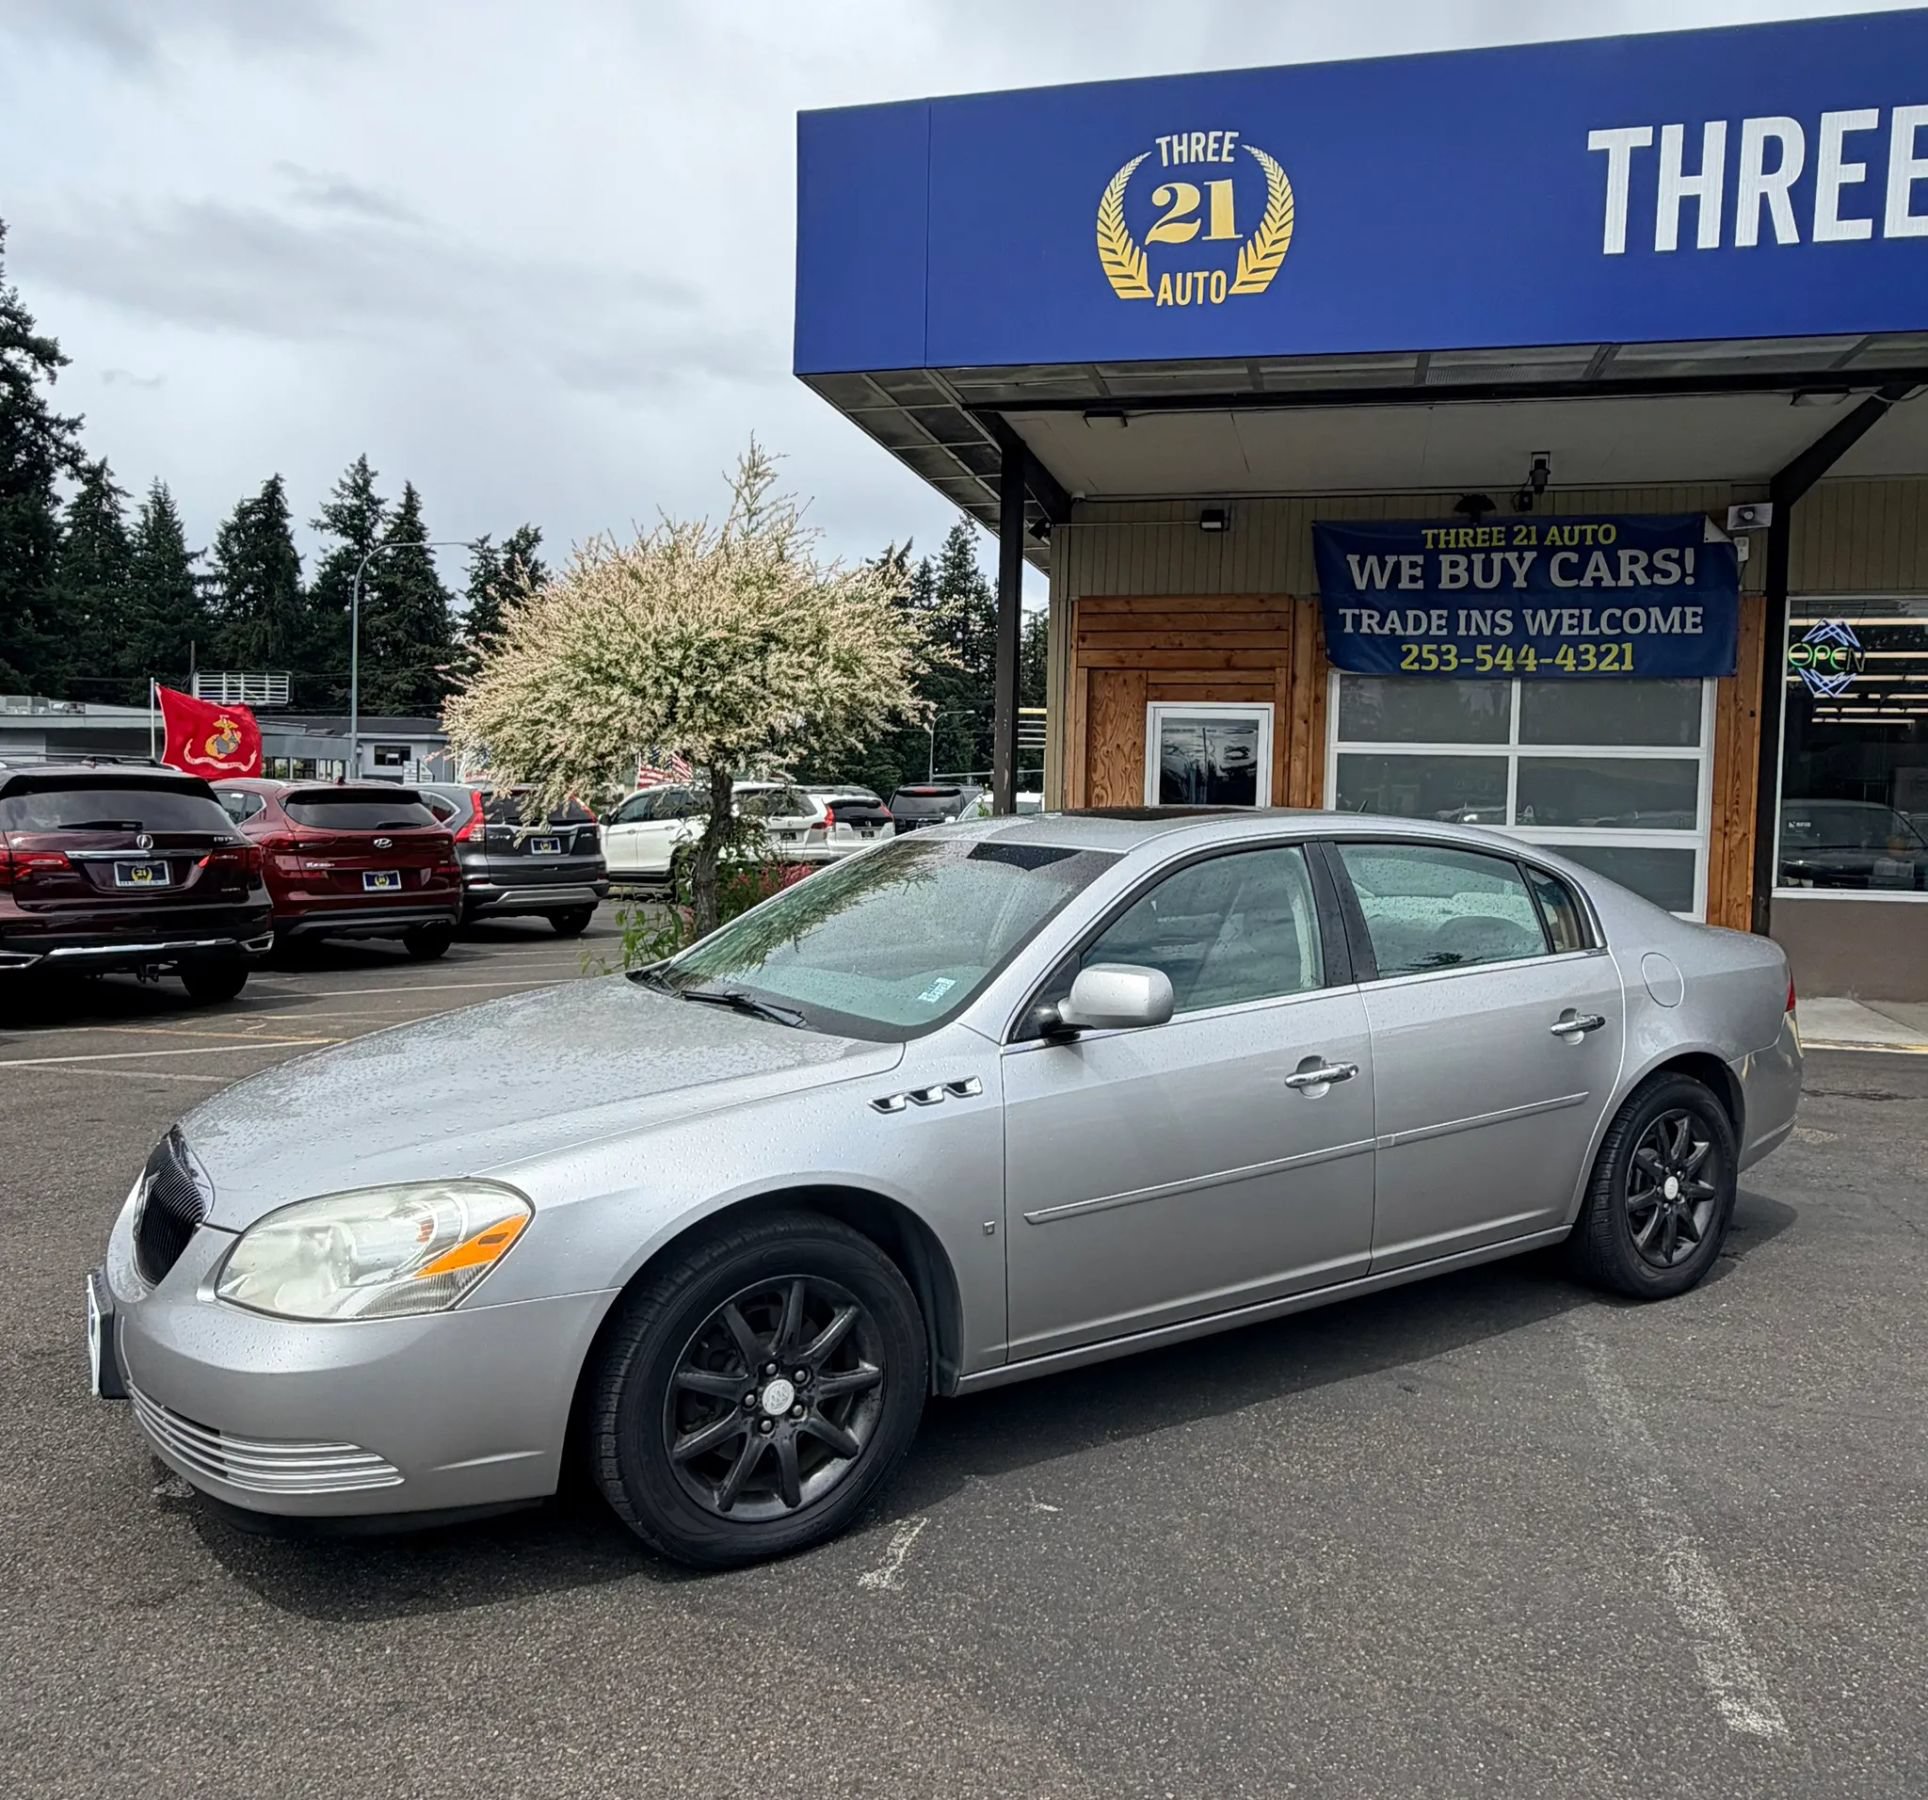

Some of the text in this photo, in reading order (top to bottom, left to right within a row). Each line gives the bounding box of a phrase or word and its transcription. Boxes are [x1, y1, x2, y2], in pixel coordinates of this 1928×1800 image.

[1155, 130, 1240, 167] THREE
[1587, 104, 1928, 255] THREE
[1144, 178, 1243, 246] 21
[1156, 270, 1227, 307] AUTO
[1421, 524, 1617, 549] THREE 21 AUTO
[1346, 548, 1695, 590] WE BUY CARS!
[1339, 606, 1703, 636] TRADE INS WELCOME
[1400, 642, 1635, 673] 253-544-4321
[1788, 643, 1866, 672] OPEN
